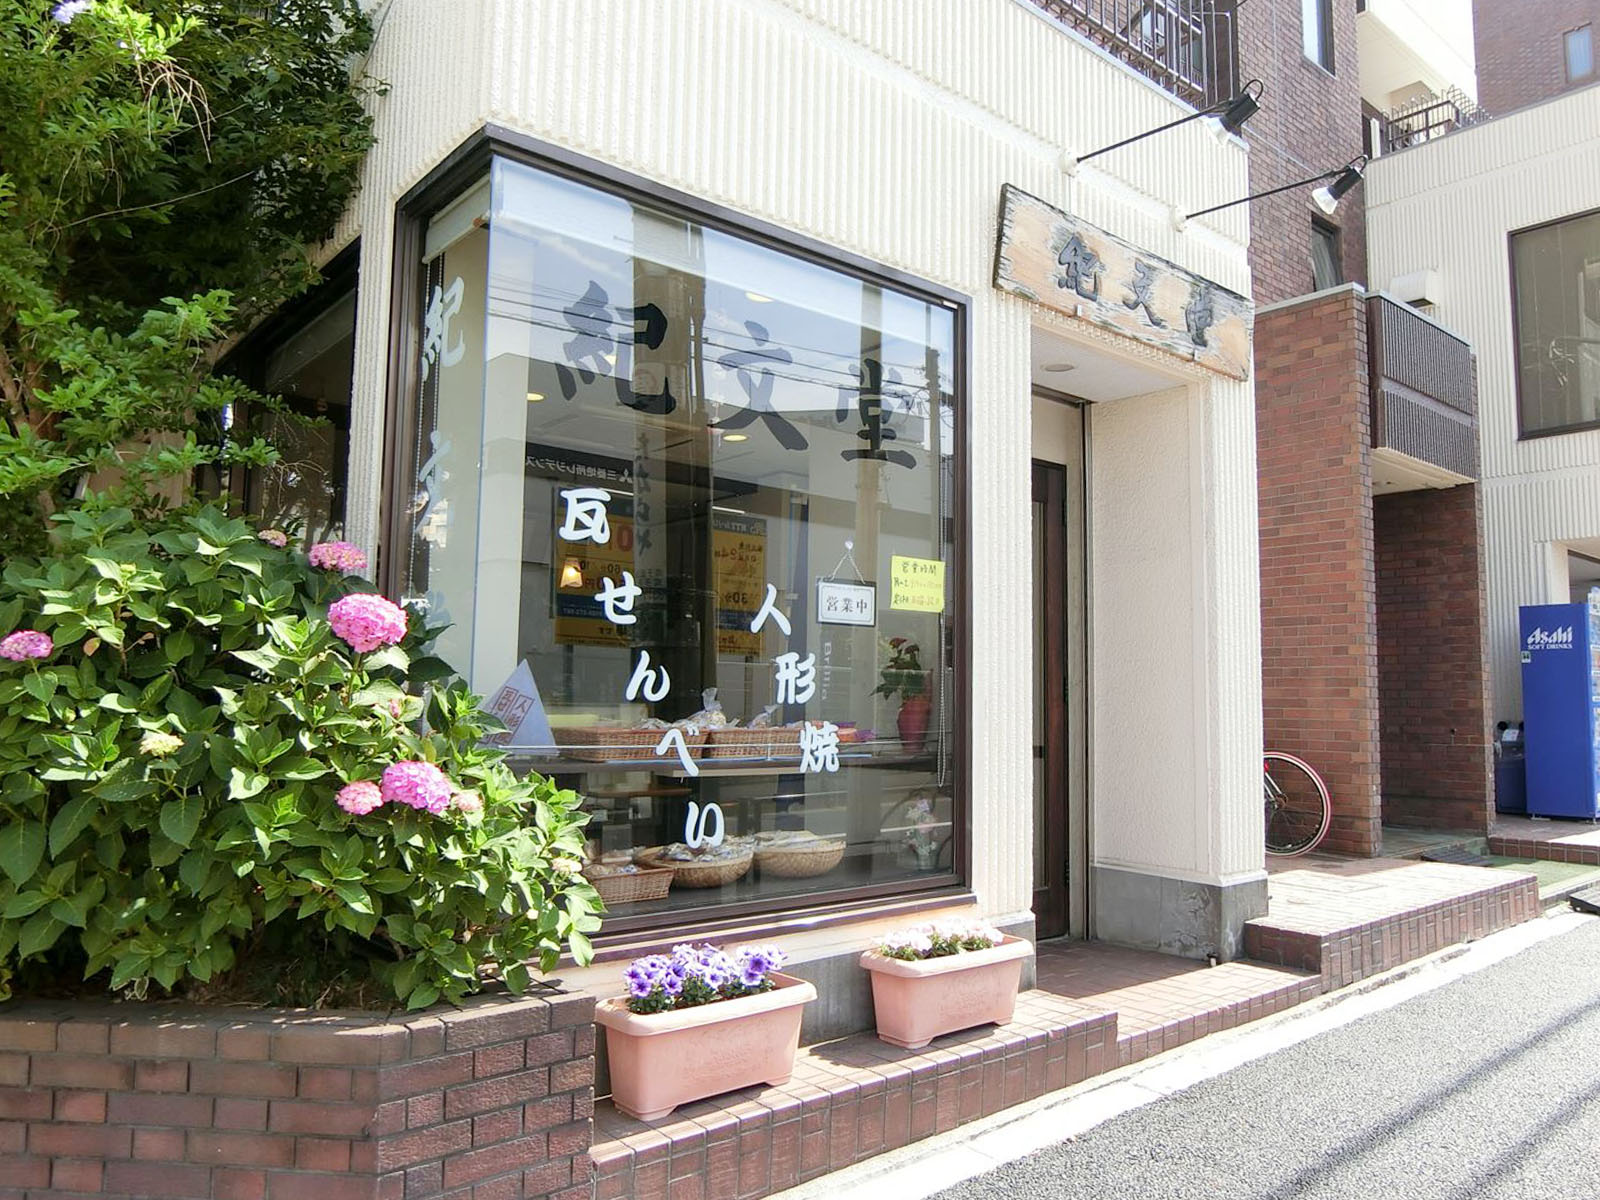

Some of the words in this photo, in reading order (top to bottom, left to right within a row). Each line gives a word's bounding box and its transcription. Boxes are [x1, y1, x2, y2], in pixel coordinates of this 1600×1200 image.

[1056, 232, 1213, 347] 紀文堂
[556, 280, 917, 469] 紀文堂
[826, 595, 868, 615] 営業中
[1527, 626, 1573, 645] Asahi
[750, 584, 840, 774] 人形焼
